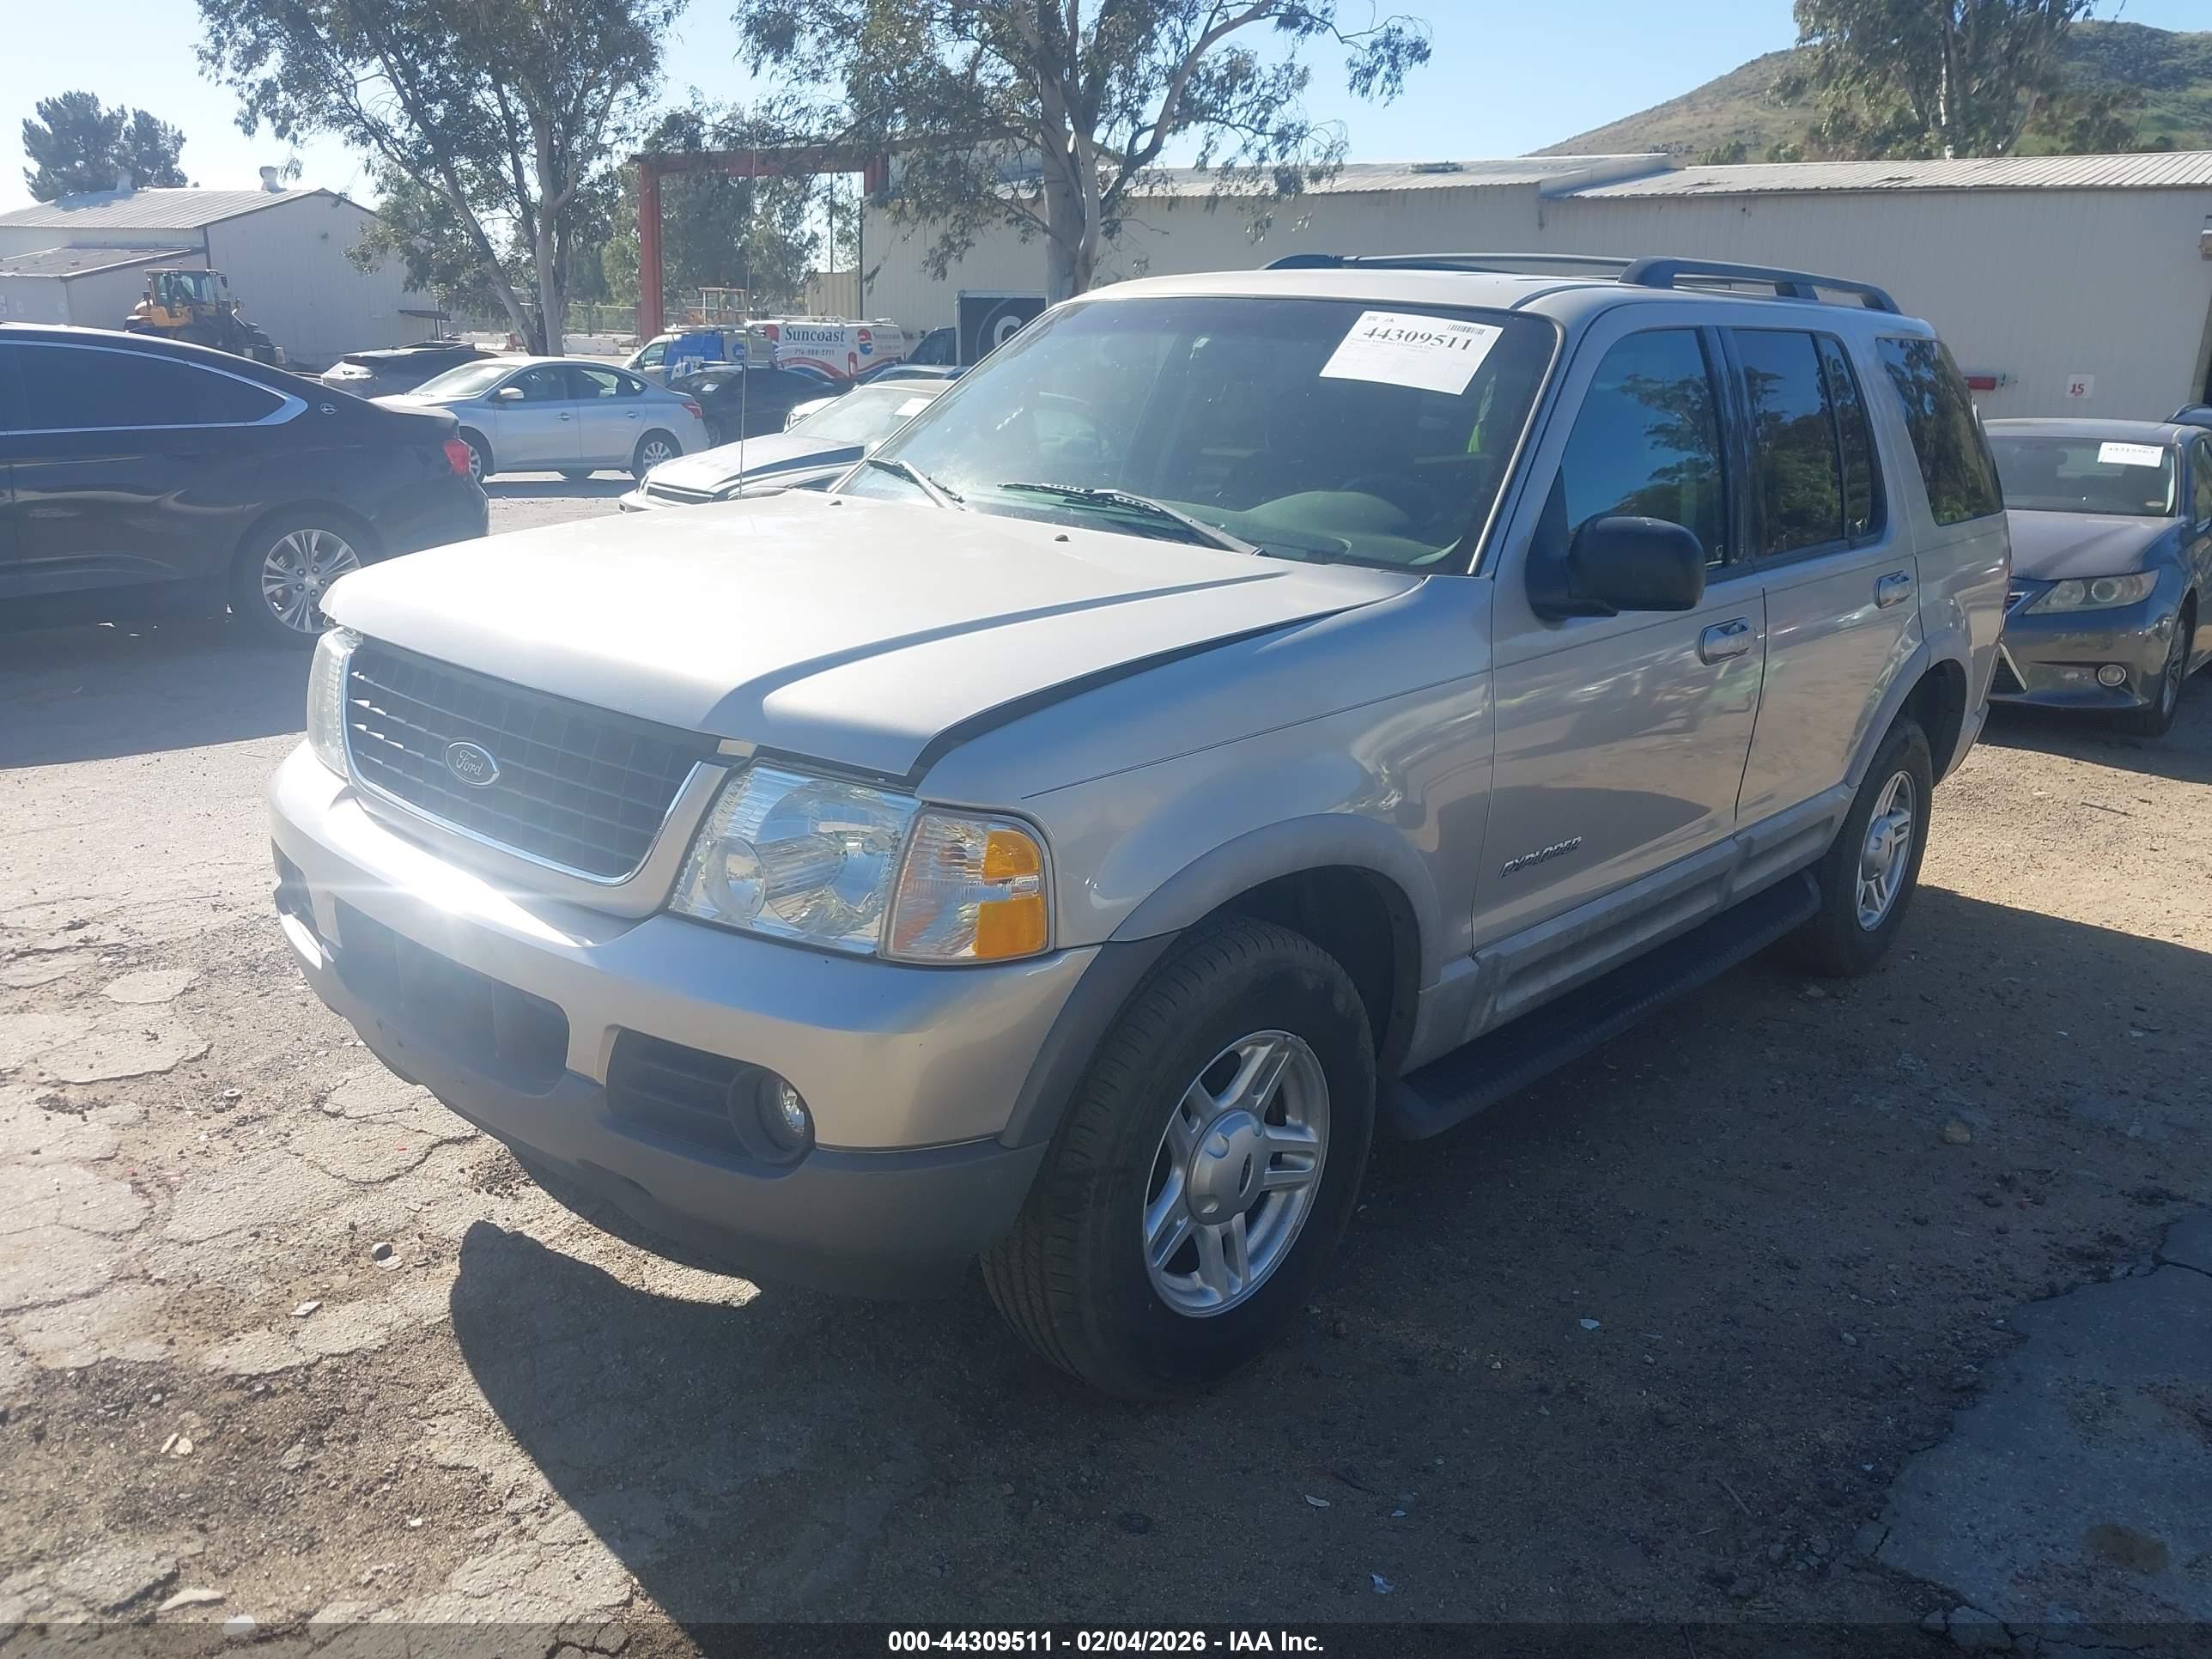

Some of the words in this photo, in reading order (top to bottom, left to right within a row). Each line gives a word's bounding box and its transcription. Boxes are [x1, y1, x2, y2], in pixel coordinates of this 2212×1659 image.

[785, 326, 846, 343] Suncoast
[1363, 326, 1473, 351] 44309511
[456, 750, 484, 776] Ford
